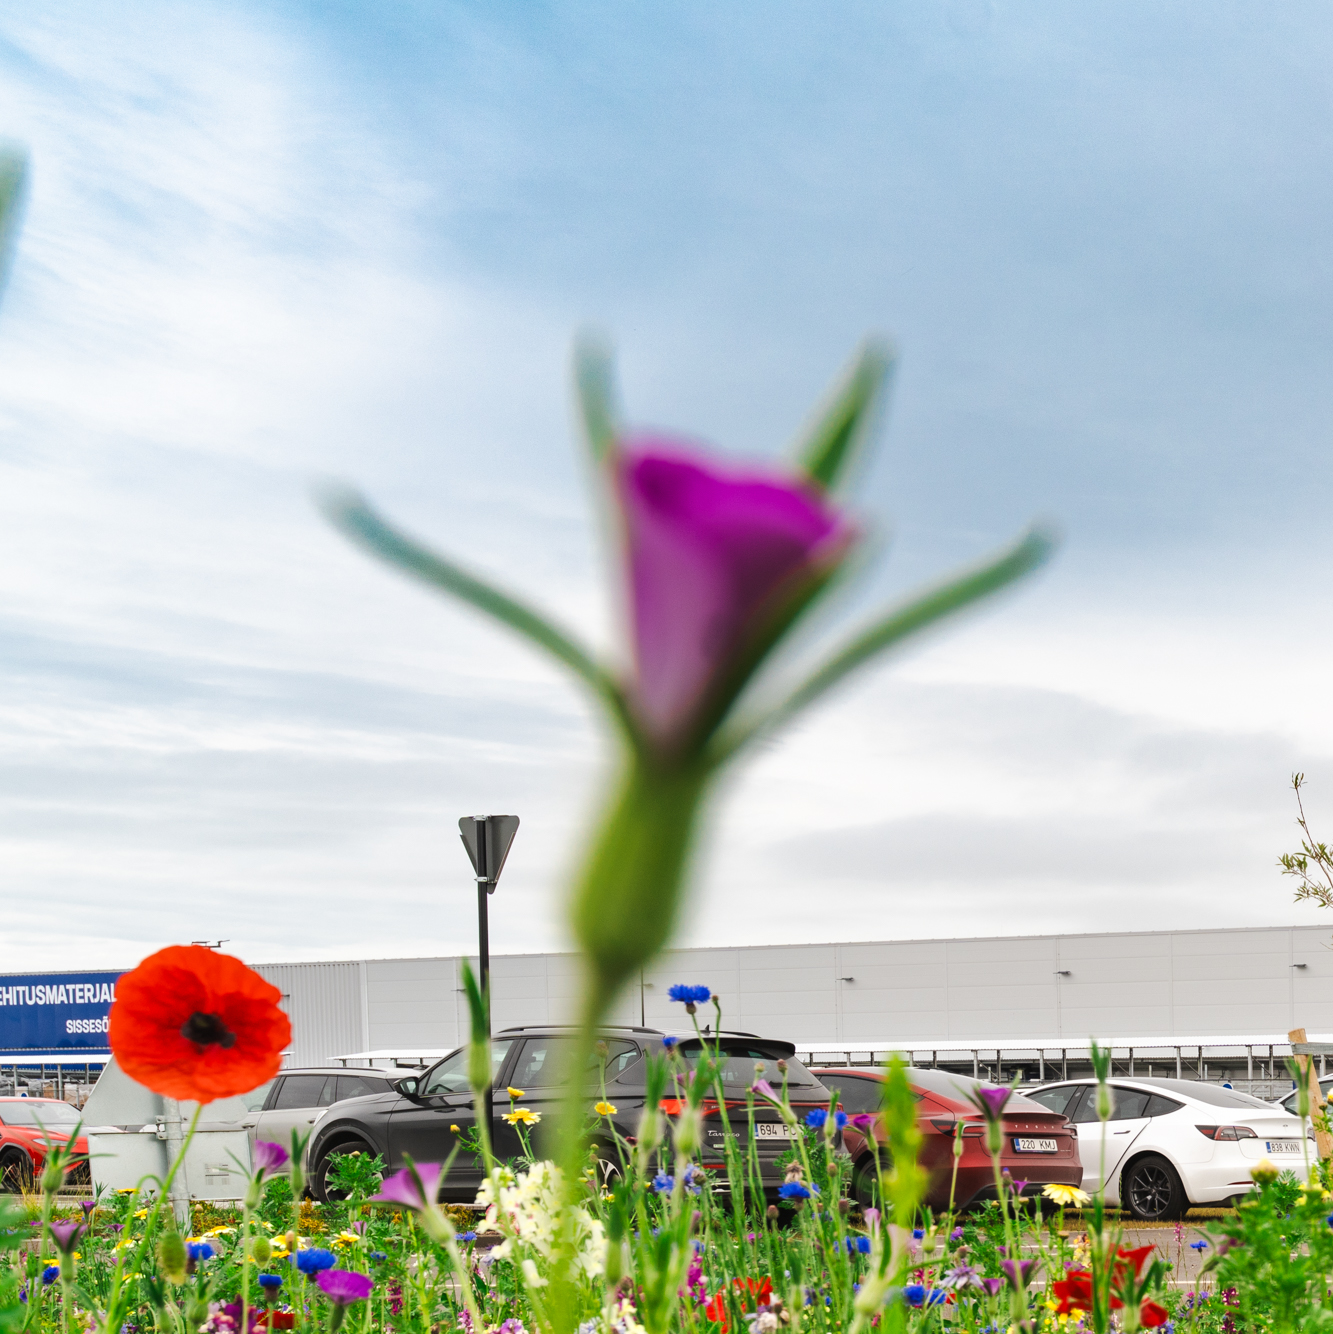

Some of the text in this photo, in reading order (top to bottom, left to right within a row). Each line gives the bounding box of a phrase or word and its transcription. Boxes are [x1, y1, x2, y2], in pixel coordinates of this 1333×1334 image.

[0, 983, 117, 1006] HITUSMATERJAL
[66, 1016, 111, 1034] SISSESÕ
[760, 1125, 778, 1135] 694
[1021, 1140, 1056, 1150] 220 KMJ
